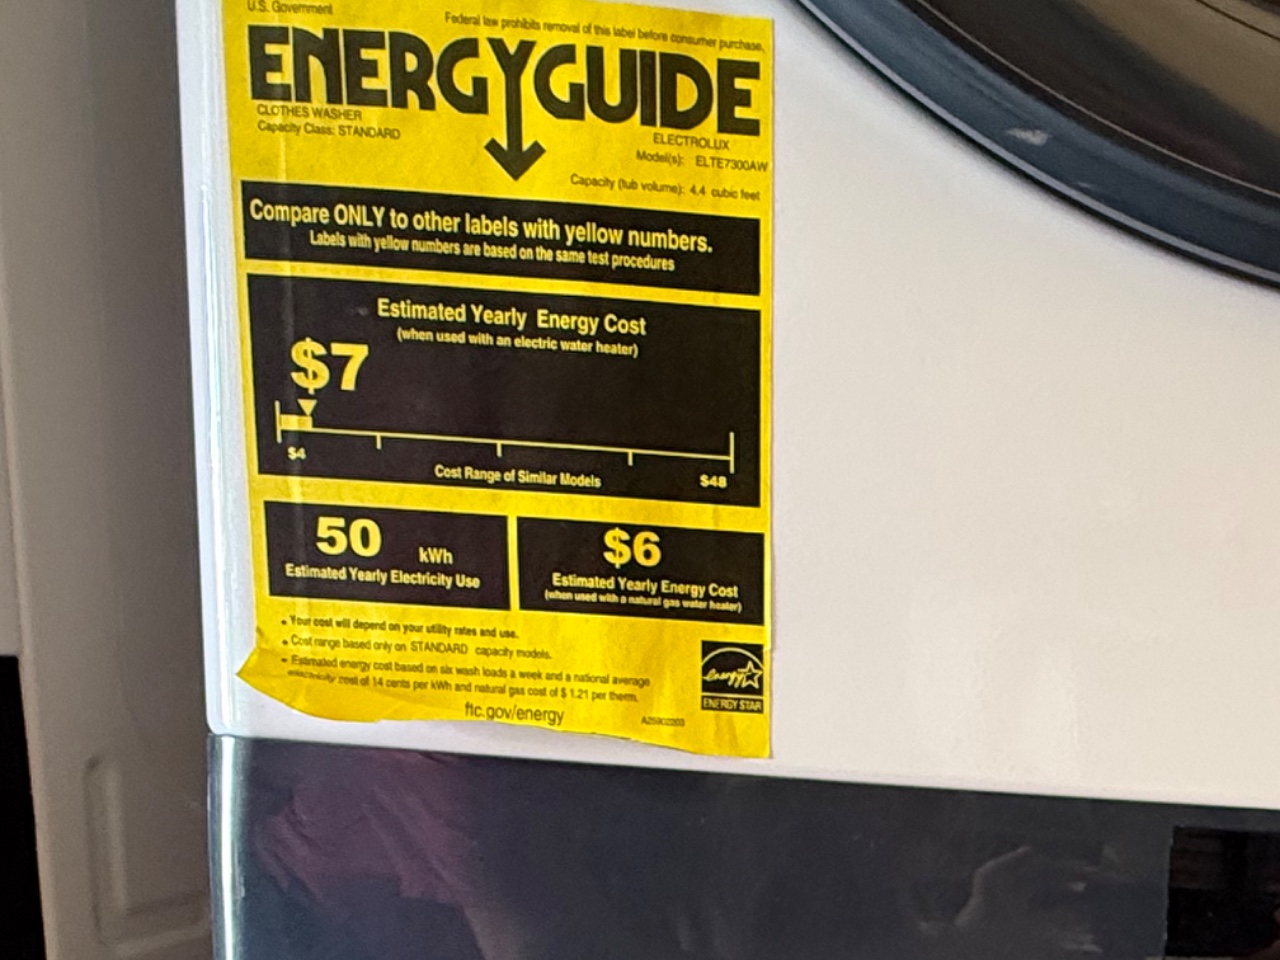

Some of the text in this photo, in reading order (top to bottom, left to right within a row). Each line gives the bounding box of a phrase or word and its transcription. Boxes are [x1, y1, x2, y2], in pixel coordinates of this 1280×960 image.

[248, 0, 333, 14] U.S. Government
[445, 11, 766, 53] Federal law prohibits removal of this label before consumer purchase.
[248, 24, 760, 137] ENERGYGUIDE
[257, 104, 362, 121] CLOTHES WASHER
[258, 121, 400, 139] Capacity Class: STANDARD
[654, 133, 730, 150] ELECTROLUX
[636, 150, 768, 172] Model(s): ELTE7300AW
[571, 174, 760, 201] Capacity (tub volume): 4.4 cubic feet
[249, 198, 713, 253] Compare ONLY to other labels with yellow numbers.
[310, 229, 675, 271] Labels with yellow numbers are based on the same test procedures
[377, 297, 646, 336] Estimated Yearly Energy Cost
[397, 328, 638, 358] (when used with an electric water heater)
[290, 336, 369, 394] $7
[287, 446, 306, 461] $4
[435, 464, 601, 488] Cost Range of Similar Models
[700, 474, 727, 490] $48
[315, 516, 454, 566] 50 kWh
[603, 527, 662, 569] $6
[285, 563, 481, 590] Estimated Yearly Electricity Use
[552, 572, 739, 598] Estimated Yearly Energy Cost
[290, 614, 519, 638] Your cost will depend on your utility rates and use.
[465, 701, 564, 726] ftc.gov/energy
[703, 698, 761, 711] ENERGY STAR
